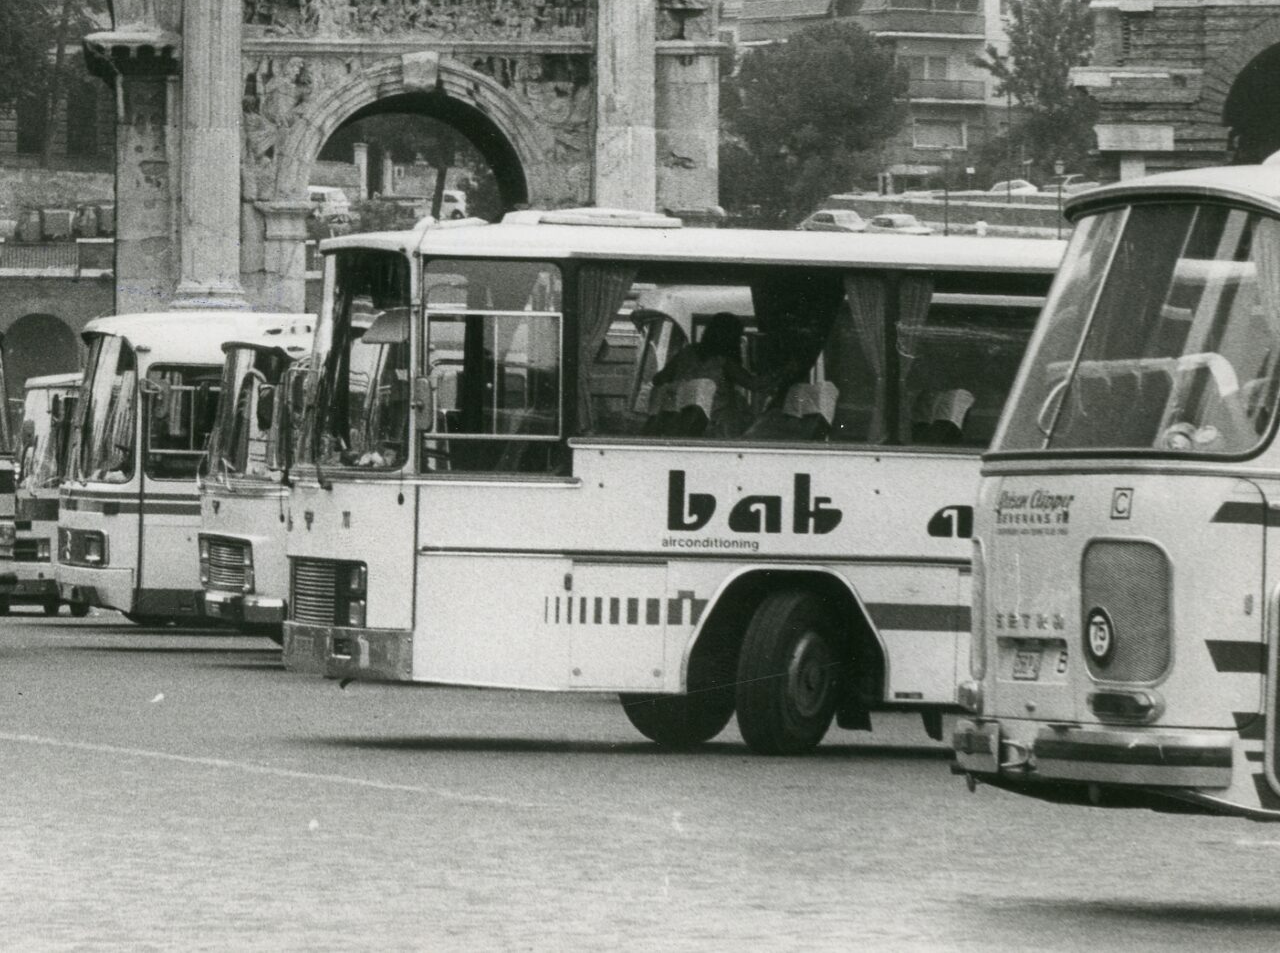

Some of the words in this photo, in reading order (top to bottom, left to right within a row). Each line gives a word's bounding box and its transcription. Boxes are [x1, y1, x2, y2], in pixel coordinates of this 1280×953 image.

[668, 470, 842, 535] bak
[662, 537, 759, 551] airconditioning
[995, 612, 1065, 630] SETRA
[1091, 620, 1107, 642] 75
